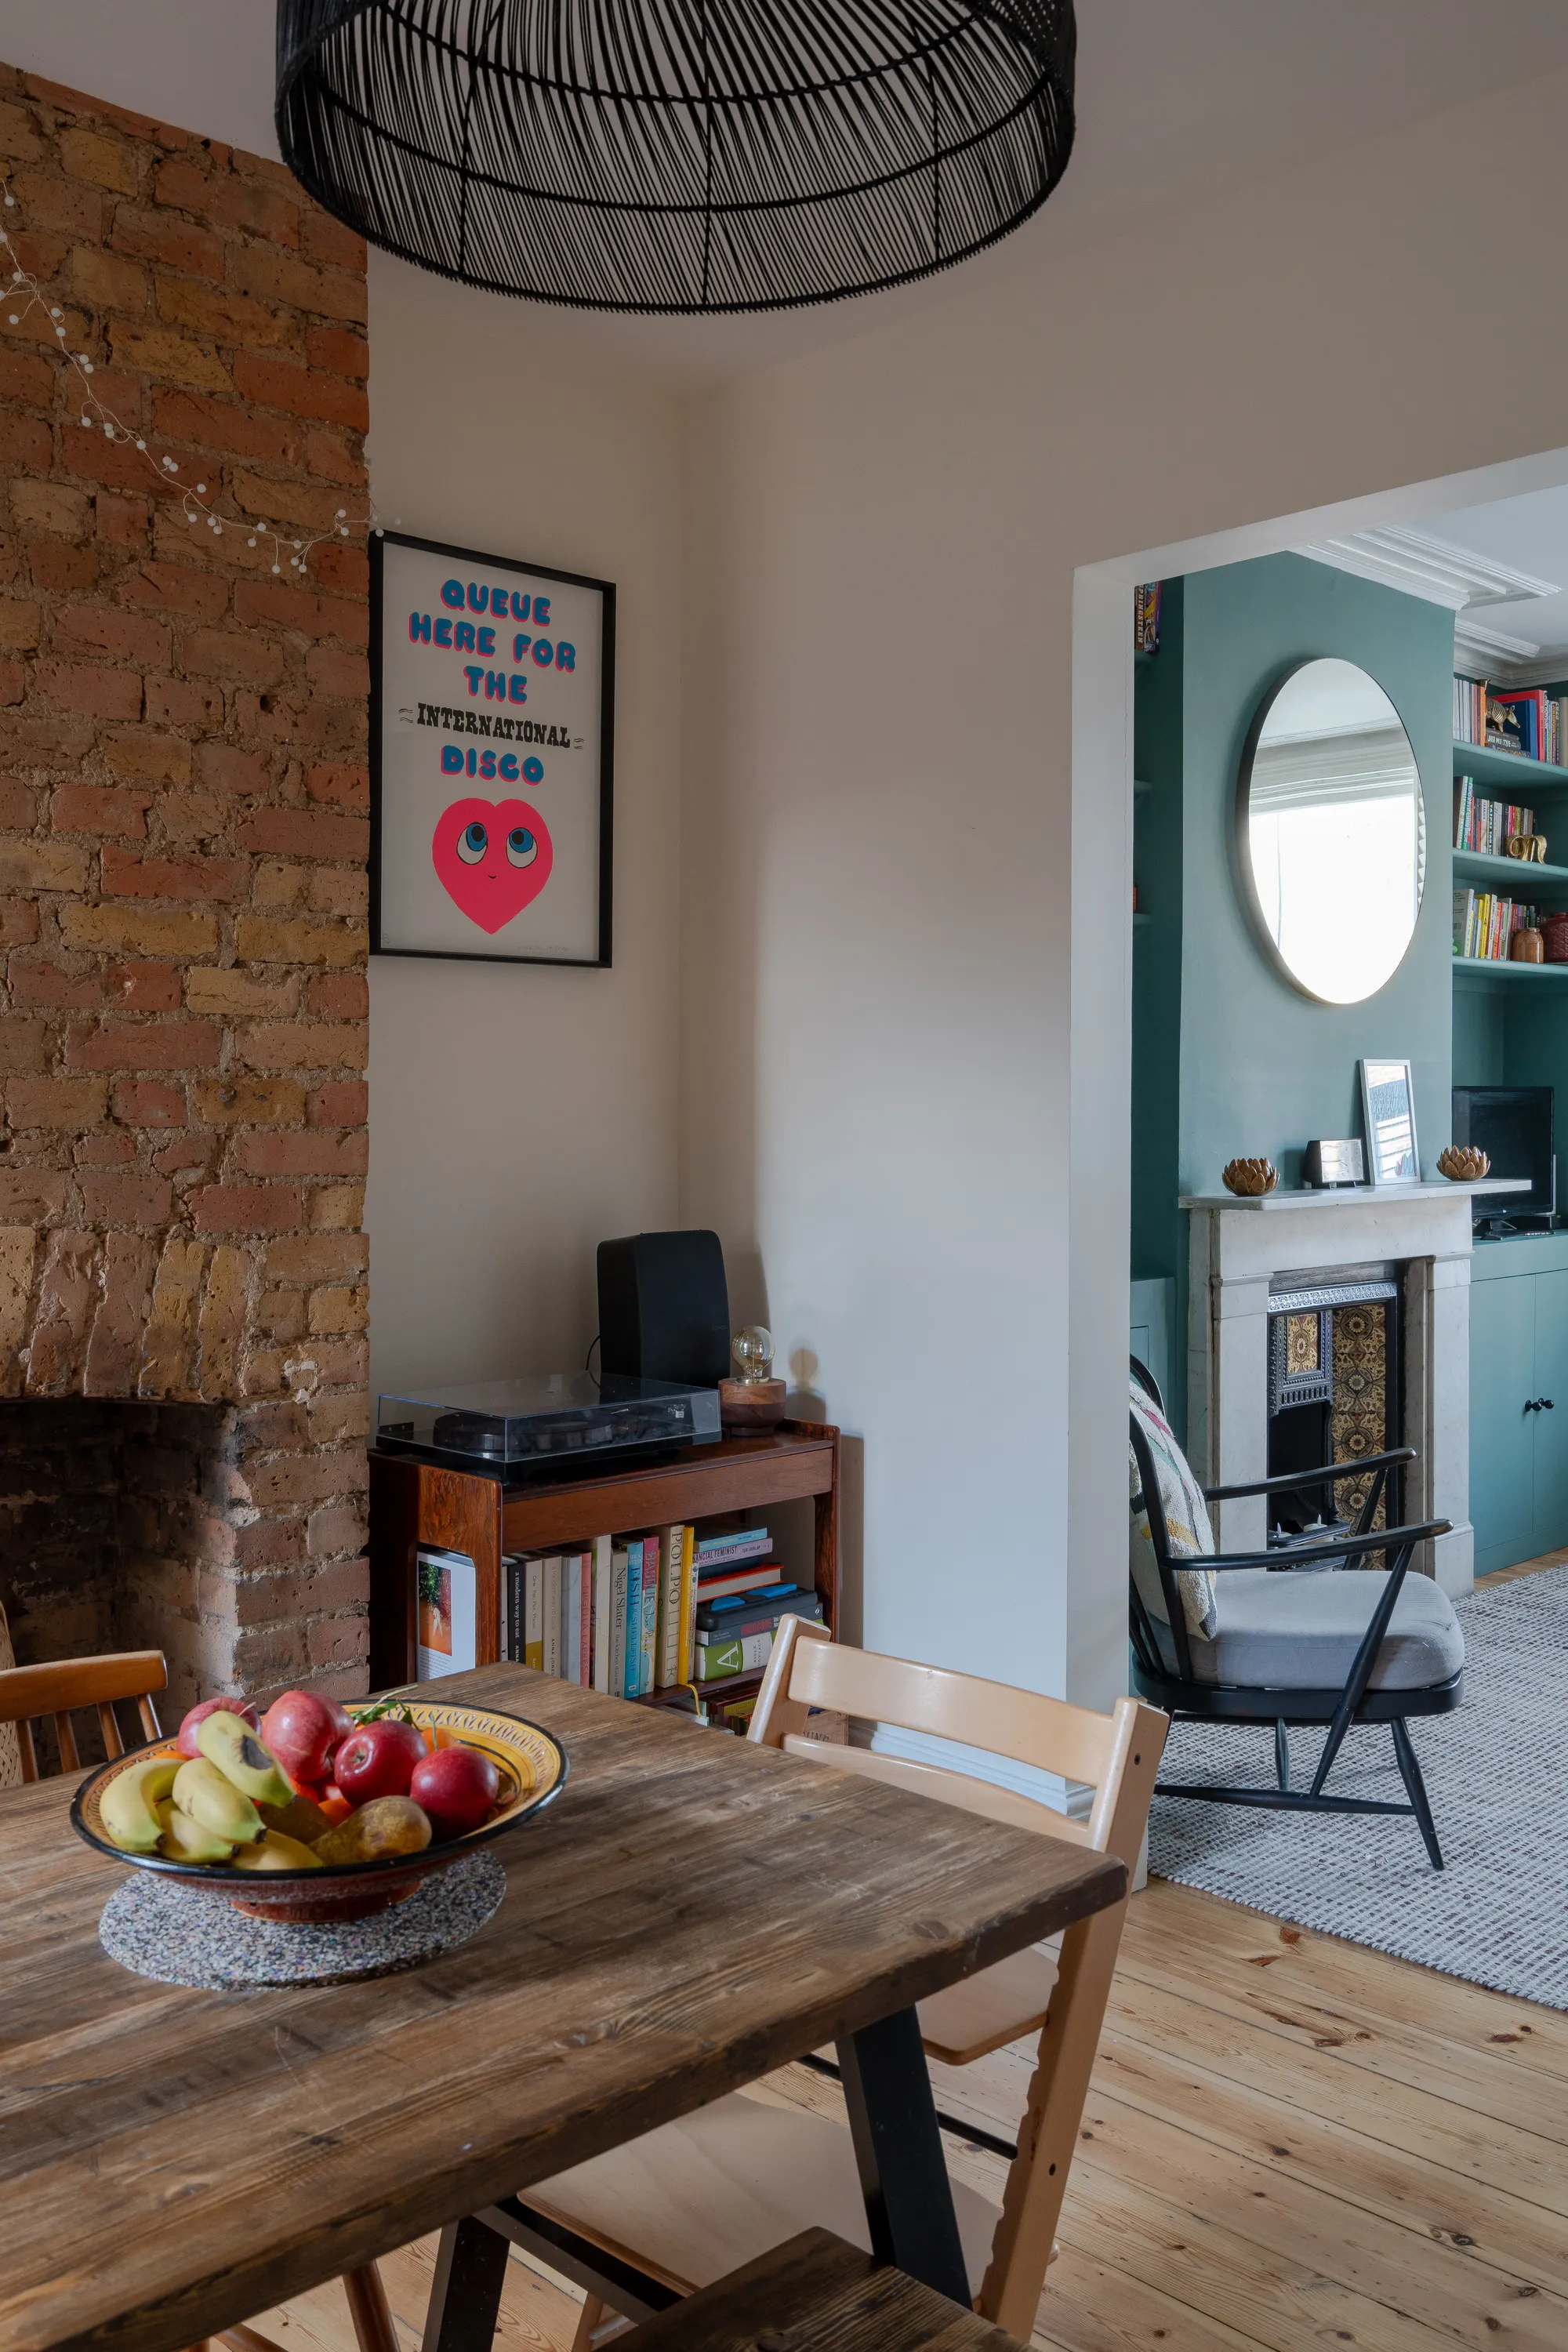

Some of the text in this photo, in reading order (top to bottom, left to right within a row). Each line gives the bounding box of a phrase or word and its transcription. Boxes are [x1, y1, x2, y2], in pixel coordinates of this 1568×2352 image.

[441, 579, 551, 626] QUEUE
[408, 612, 576, 673] HERE FOR
[463, 666, 528, 705] THE
[416, 702, 572, 749] INTERNATIONAL
[441, 745, 544, 786] DISCO
[669, 1532, 683, 1606] POLPO
[714, 1545, 738, 1558] FEMINIST
[613, 1567, 626, 1629] Nigel Slater
[629, 1566, 641, 1606] FISH
[644, 1552, 656, 1602] BASQUE
[581, 1585, 590, 1631] NIGELLA
[630, 1617, 638, 1671] SHELLFISH
[717, 1642, 739, 1671] A
